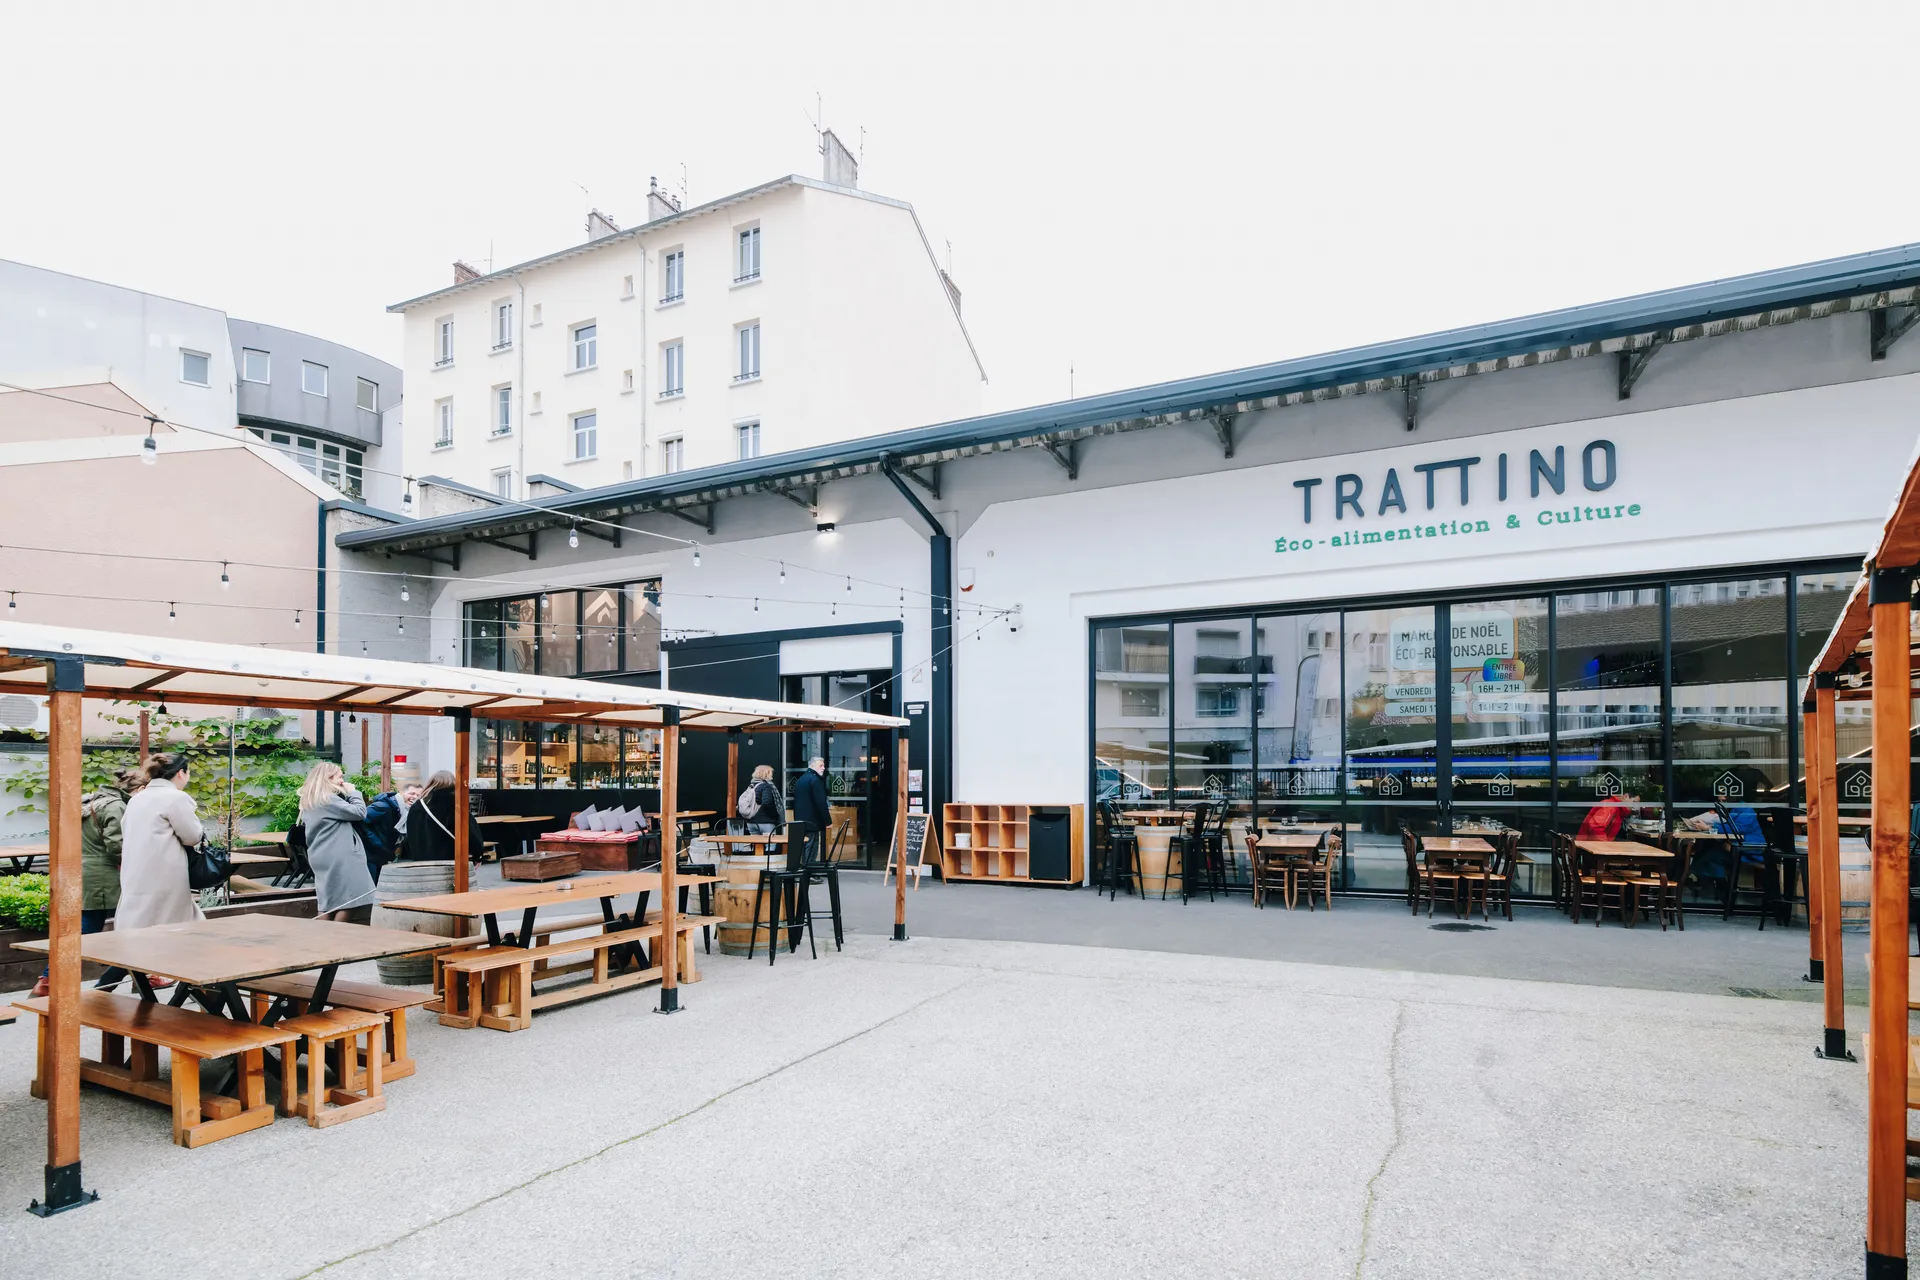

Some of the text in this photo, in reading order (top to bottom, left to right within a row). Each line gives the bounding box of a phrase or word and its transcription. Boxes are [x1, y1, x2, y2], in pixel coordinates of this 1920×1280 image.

[1293, 439, 1617, 524] TRATTINO
[1506, 514, 1521, 529] &
[1537, 503, 1641, 526] Culture
[1401, 622, 1502, 642] MARC DE NOËL
[1491, 663, 1517, 671] ENTRÉE
[1493, 672, 1513, 680] LIBRE
[1395, 687, 1432, 697] VENDREDI
[1479, 685, 1494, 693] 16H
[1503, 684, 1520, 692] 21H
[1400, 705, 1427, 713] SAMEDI
